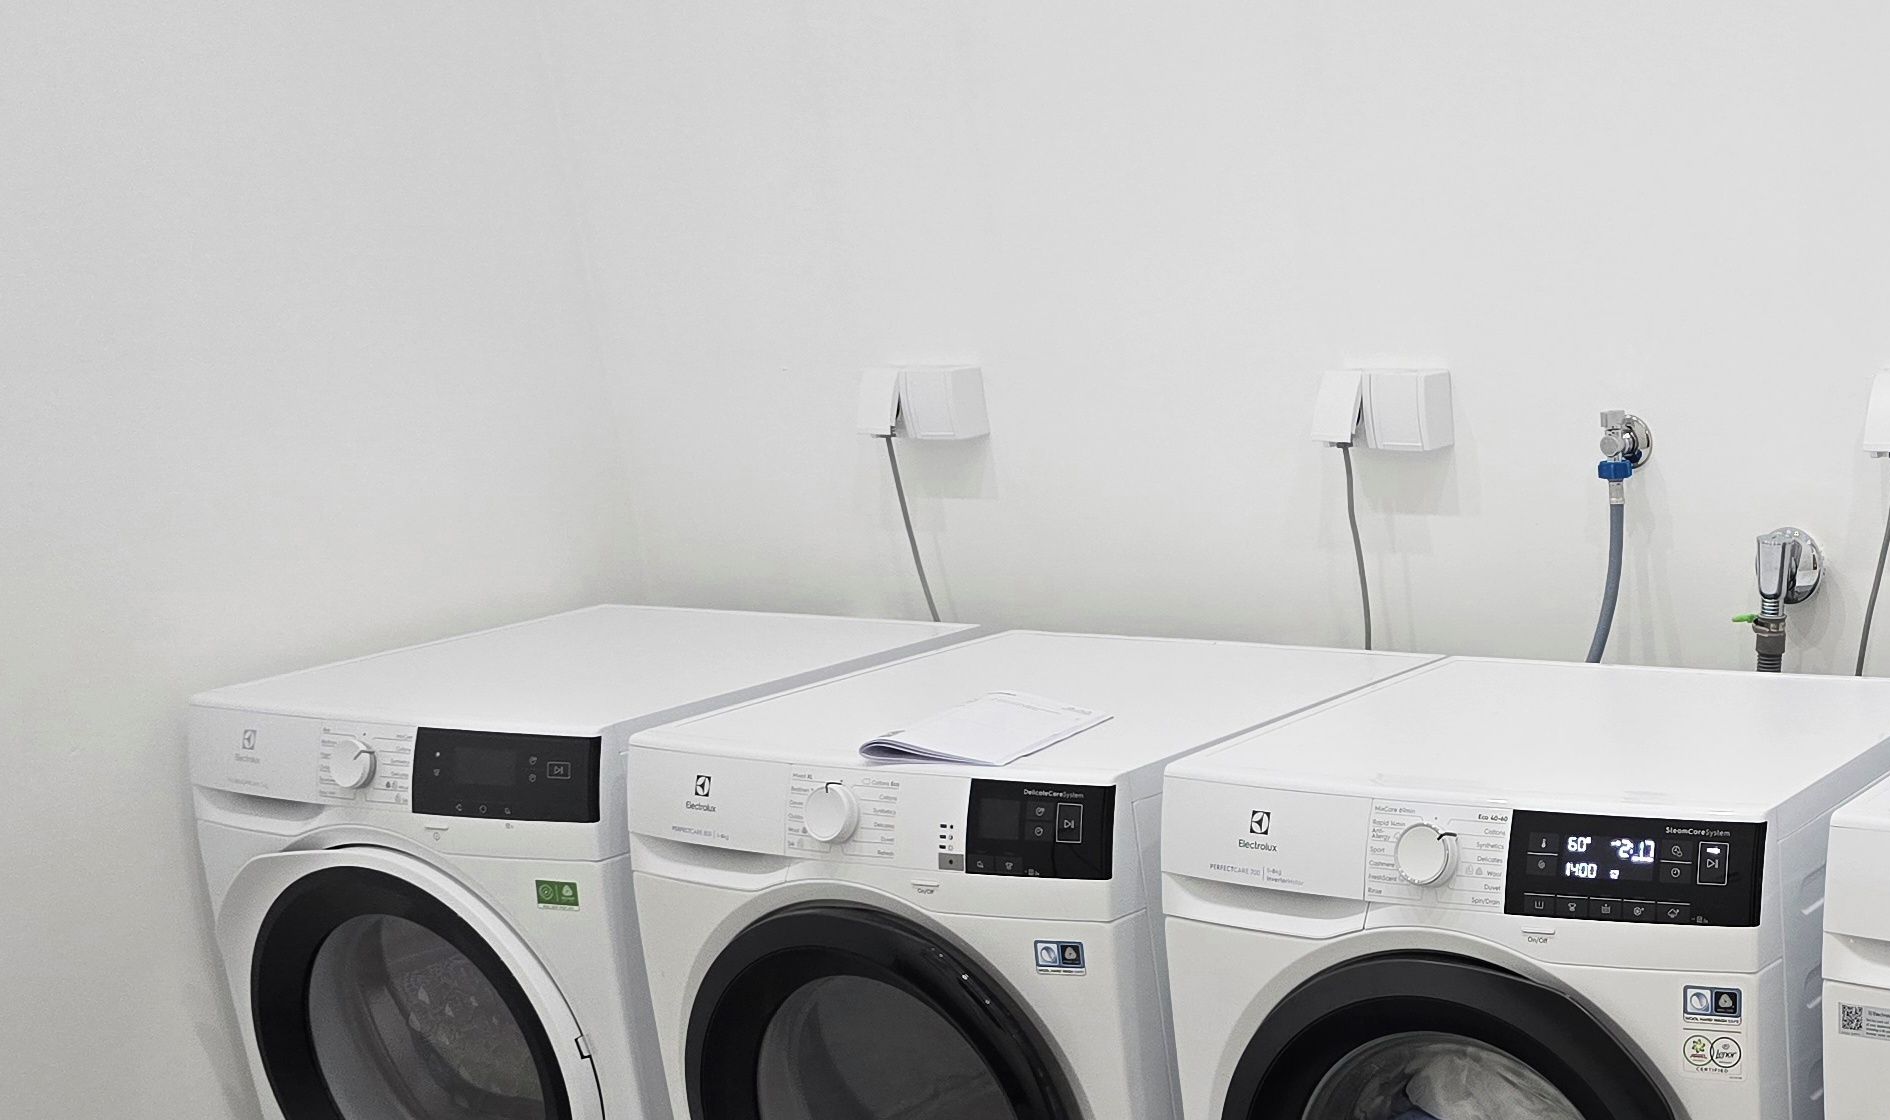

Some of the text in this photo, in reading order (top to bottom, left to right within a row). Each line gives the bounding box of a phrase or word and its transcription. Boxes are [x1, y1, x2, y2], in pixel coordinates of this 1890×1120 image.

[1490, 814, 1508, 822] 40-60
[1665, 826, 1731, 837] SteamCareSystem
[1238, 838, 1278, 852] Electrolux
[1209, 864, 1249, 874] PERFECTCARE
[1564, 862, 1598, 879] 1400
[1527, 936, 1548, 944] On/Off
